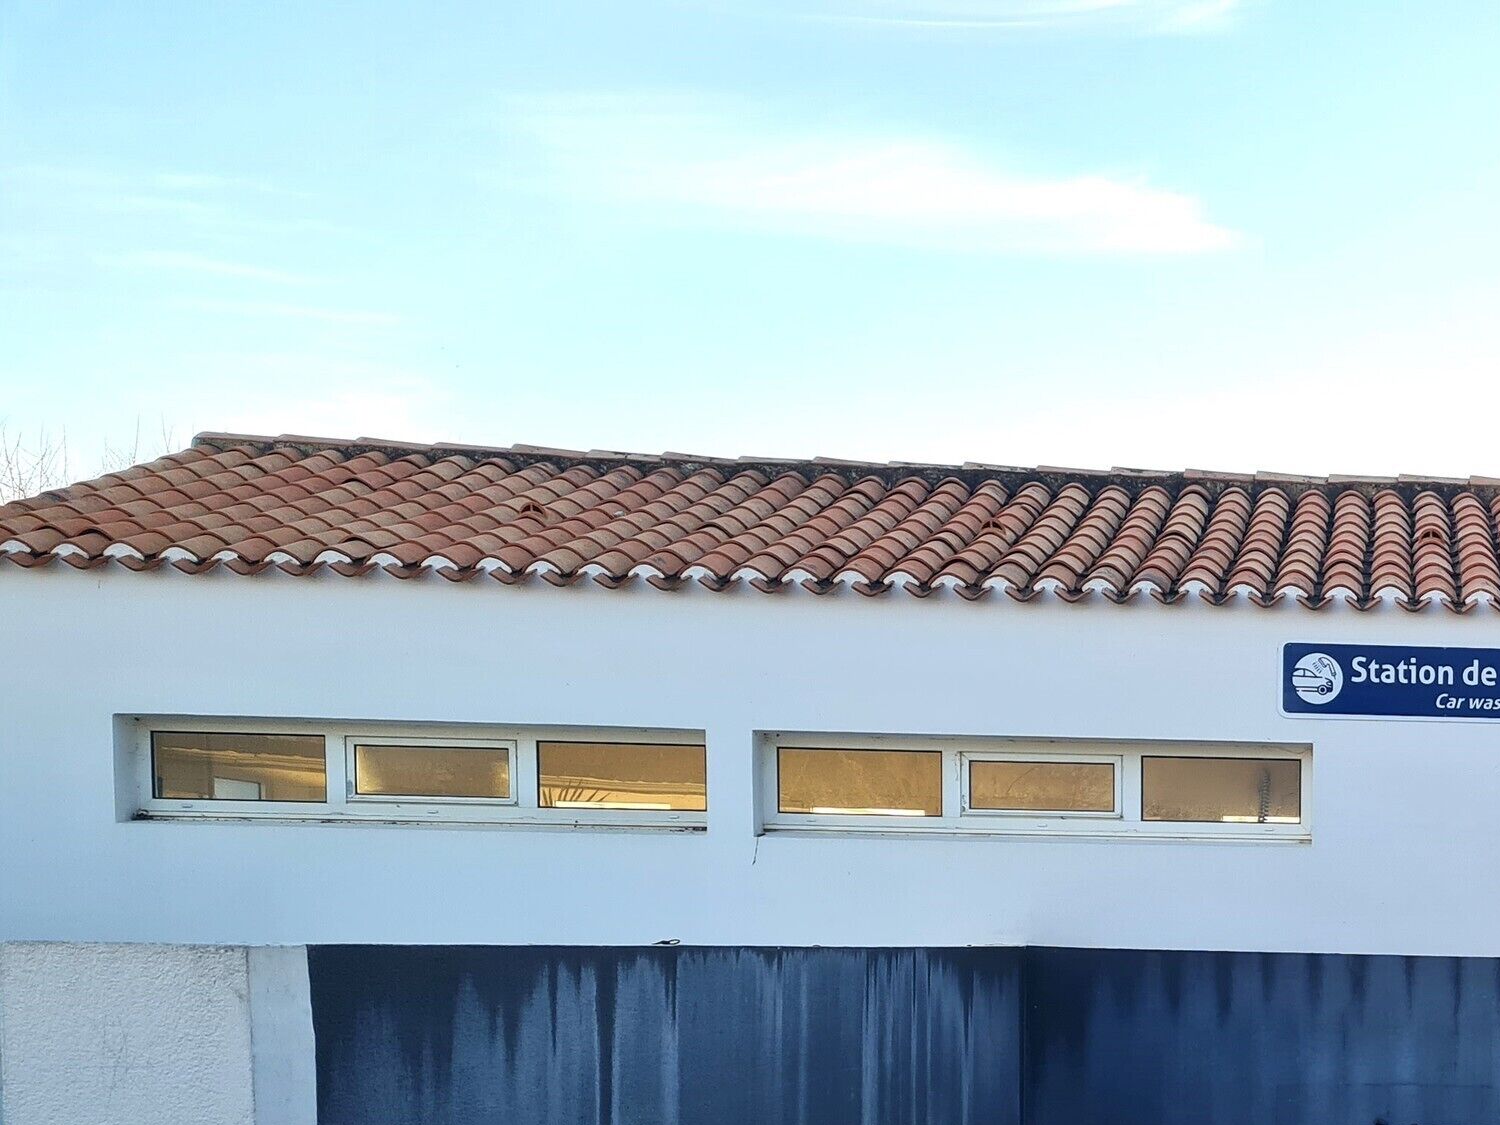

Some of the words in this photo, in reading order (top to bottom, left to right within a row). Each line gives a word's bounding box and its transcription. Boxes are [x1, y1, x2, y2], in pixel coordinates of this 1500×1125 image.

[1350, 656, 1454, 685] Station
[1462, 659, 1497, 686] de
[1435, 693, 1465, 710] Car
